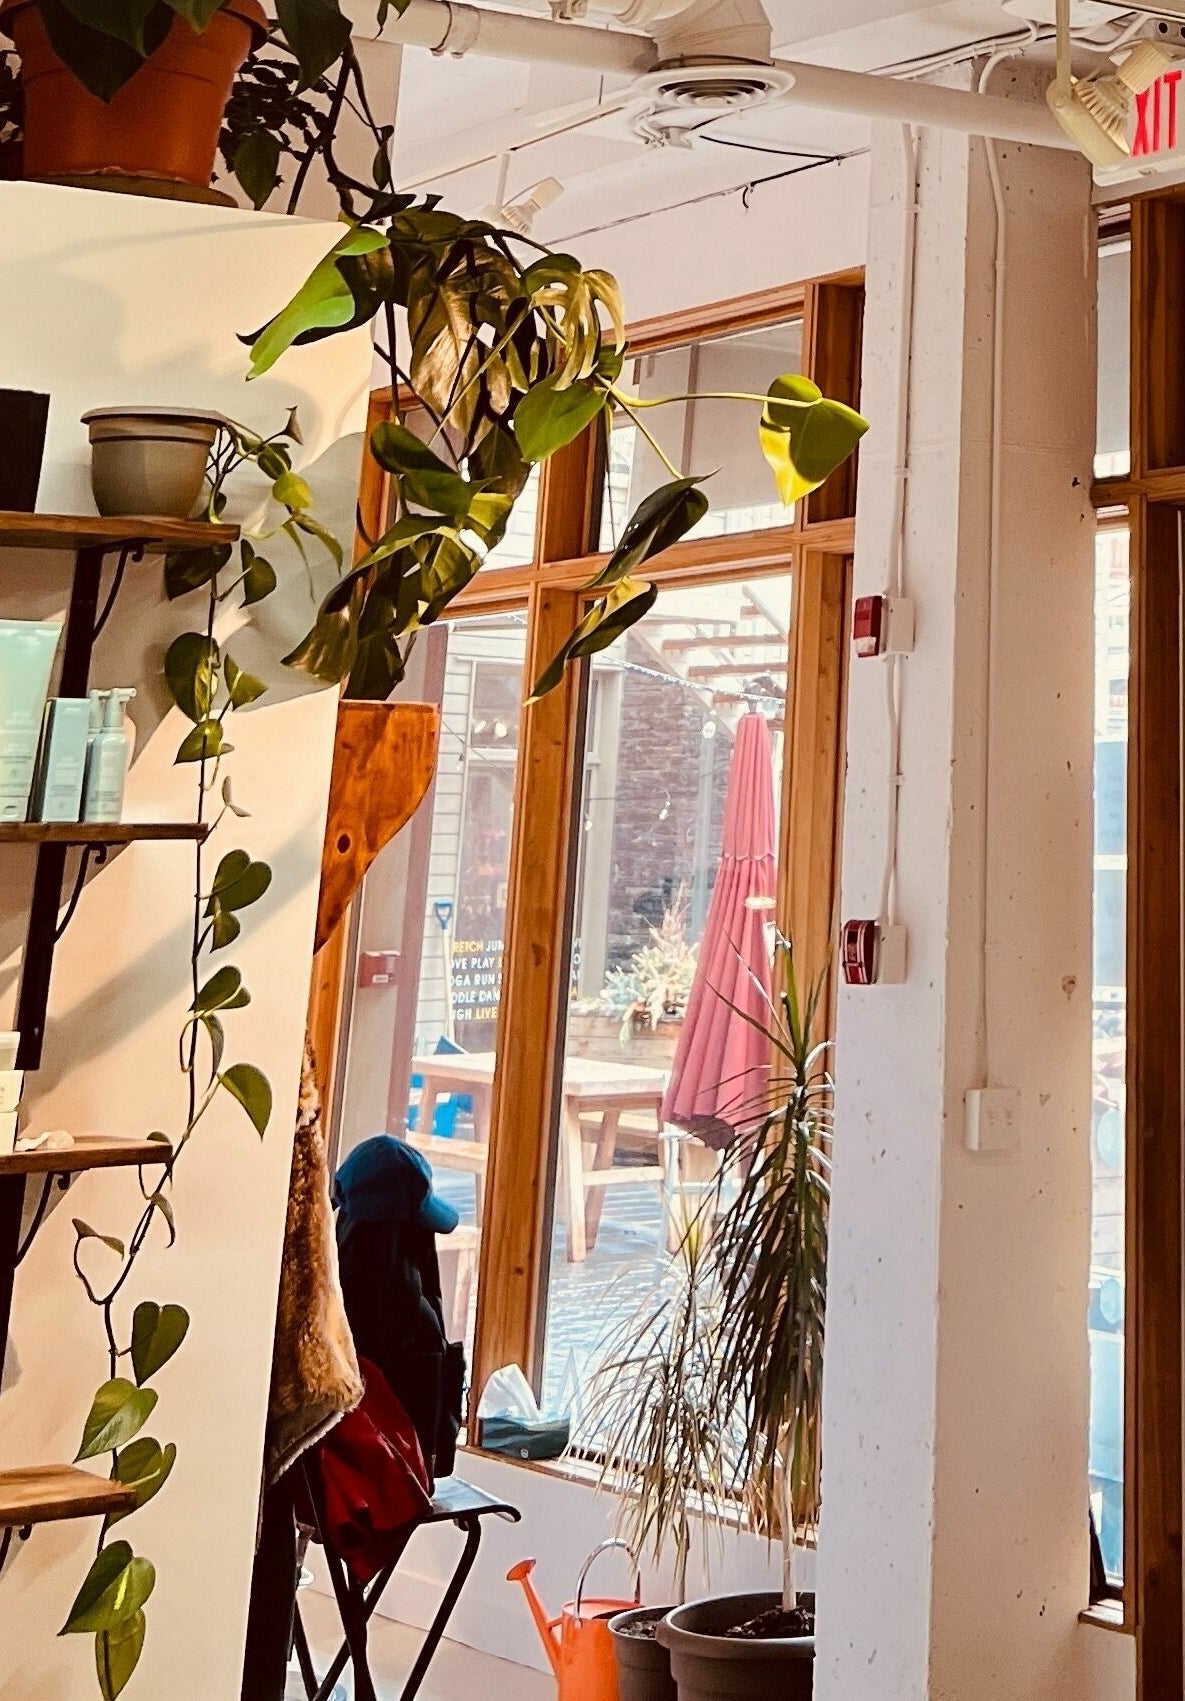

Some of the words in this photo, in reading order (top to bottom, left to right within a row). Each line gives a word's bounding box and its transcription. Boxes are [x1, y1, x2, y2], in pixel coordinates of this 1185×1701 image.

[1132, 70, 1182, 157] XIT
[453, 942, 483, 952] RETCH
[471, 956, 495, 969] PLAY
[450, 975, 470, 987] OGA
[474, 974, 495, 986] RUN
[451, 991, 477, 1004] DDLE
[478, 990, 500, 1002] DAN
[475, 1007, 497, 1019] LIVE
